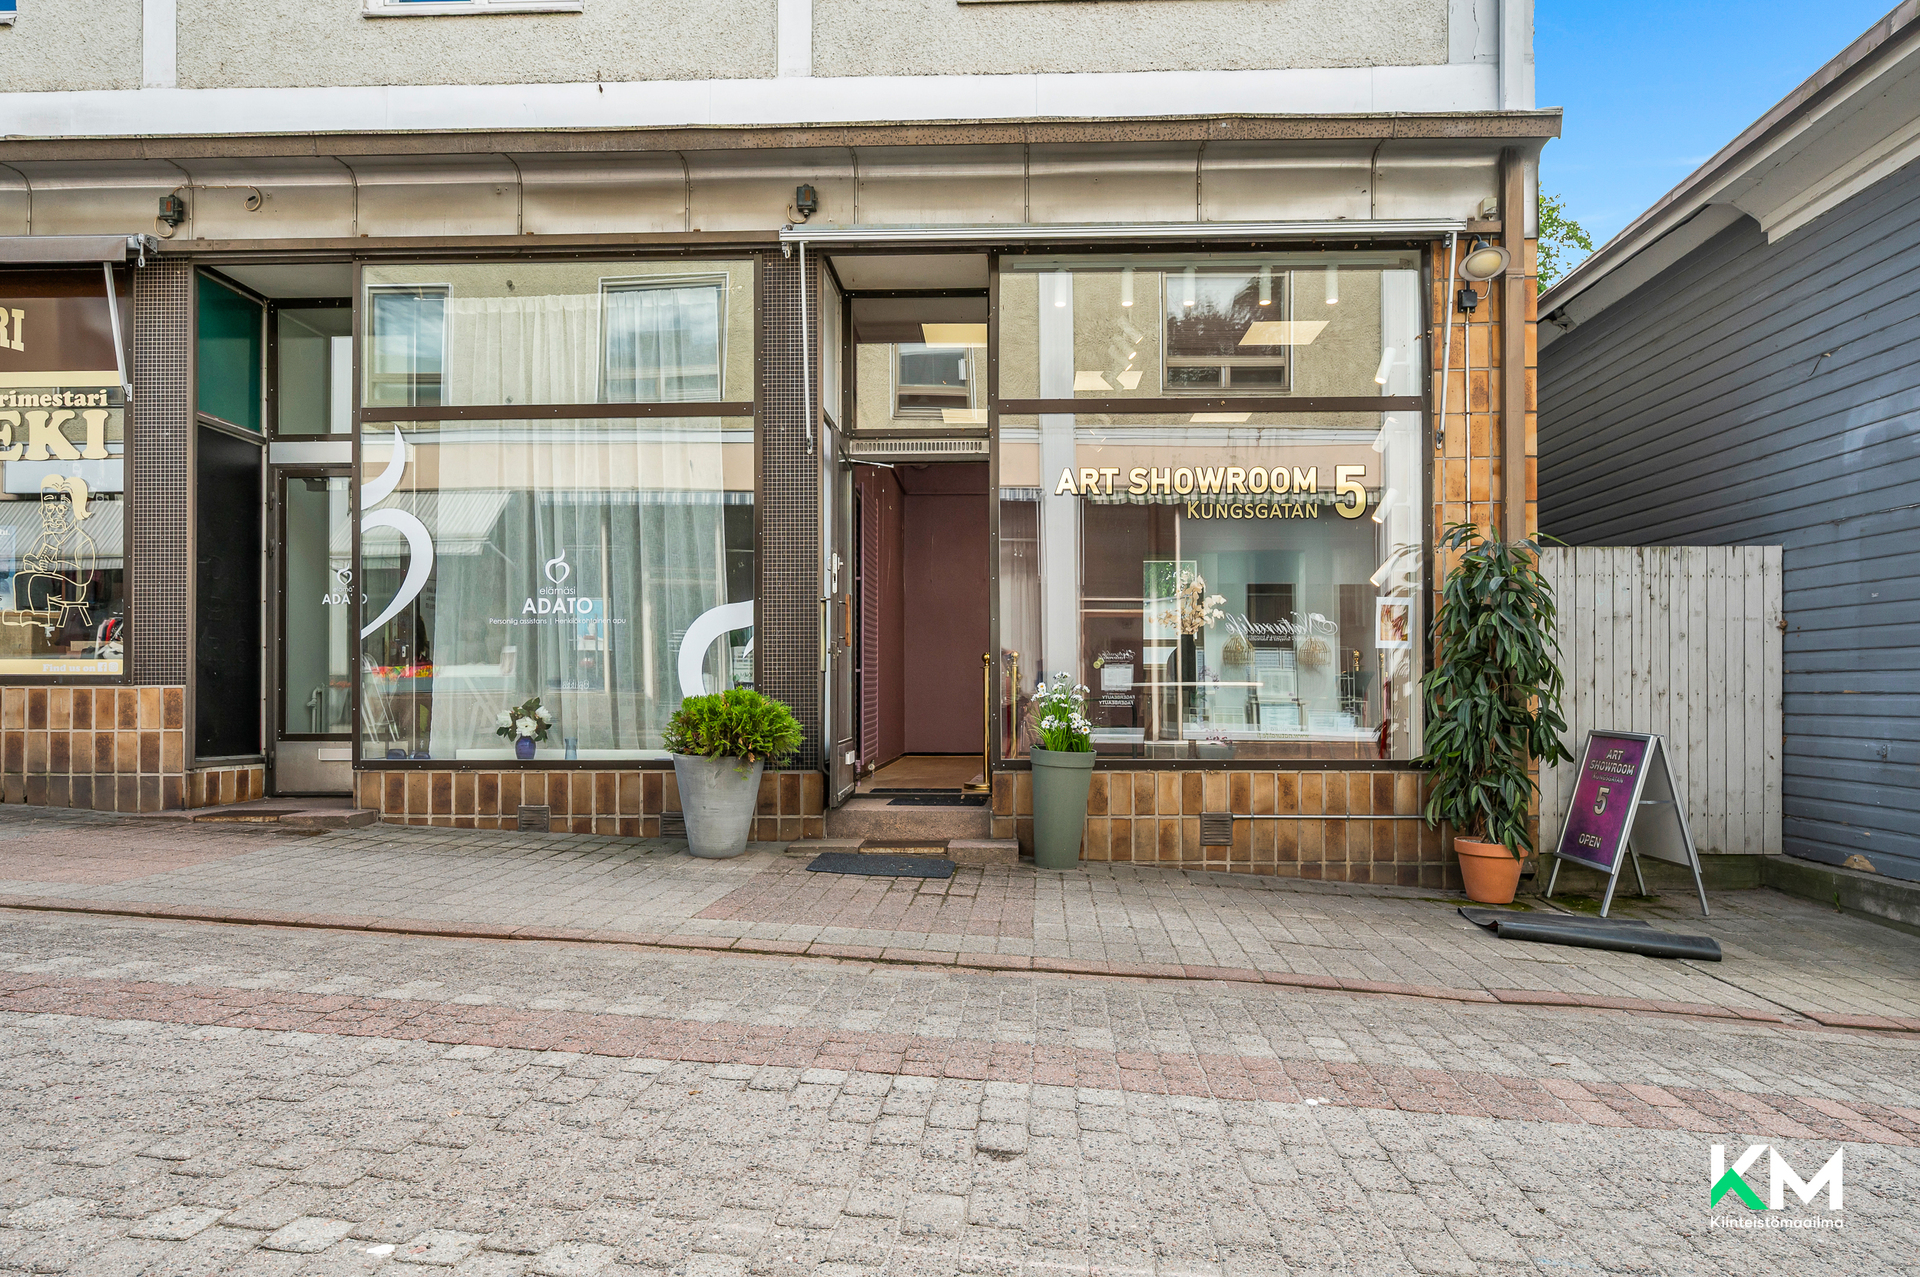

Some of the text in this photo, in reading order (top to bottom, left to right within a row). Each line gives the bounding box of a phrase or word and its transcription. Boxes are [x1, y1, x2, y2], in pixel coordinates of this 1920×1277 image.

[1054, 464, 1367, 520] ART SHOWROOM 5
[1187, 500, 1319, 520] KUNGSGATAN
[539, 586, 576, 595] elämäsi
[522, 597, 593, 614] ADATO
[612, 618, 627, 626] apu
[42, 663, 67, 672] Find
[1605, 749, 1624, 760] ART
[1588, 759, 1637, 776] SHOWROOM
[1593, 785, 1611, 816] 5
[1578, 832, 1602, 849] OPEN
